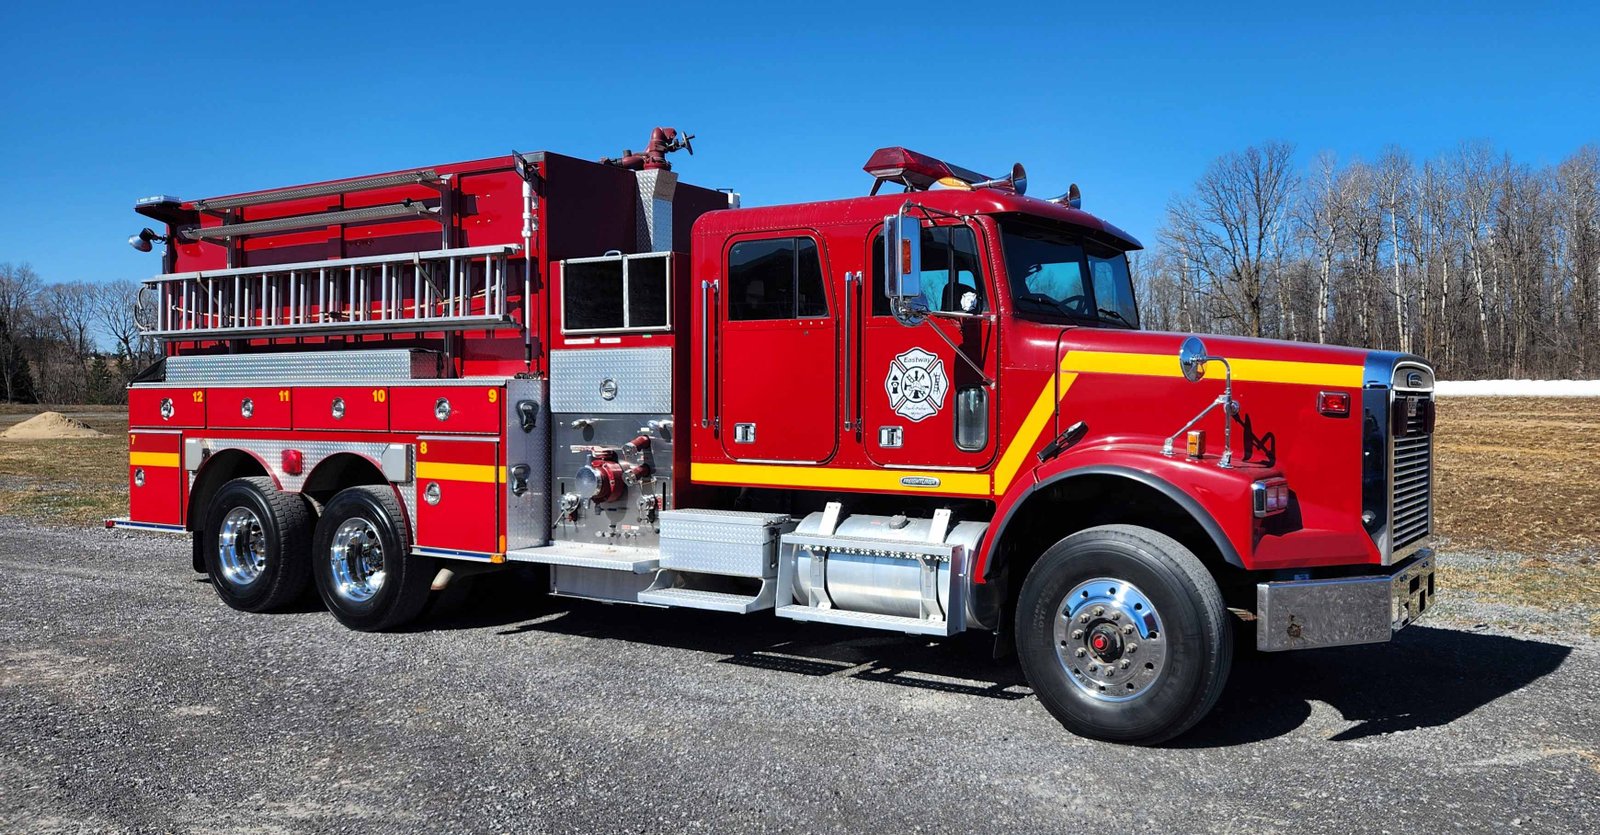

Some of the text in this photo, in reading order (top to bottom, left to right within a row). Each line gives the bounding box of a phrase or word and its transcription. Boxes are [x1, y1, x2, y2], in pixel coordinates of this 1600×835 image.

[903, 356, 931, 364] Eastway
[192, 390, 203, 403] 12
[278, 390, 290, 402] 11
[372, 389, 386, 403] 10
[487, 389, 498, 403] 9
[130, 434, 136, 445] 7
[420, 441, 428, 455] 8
